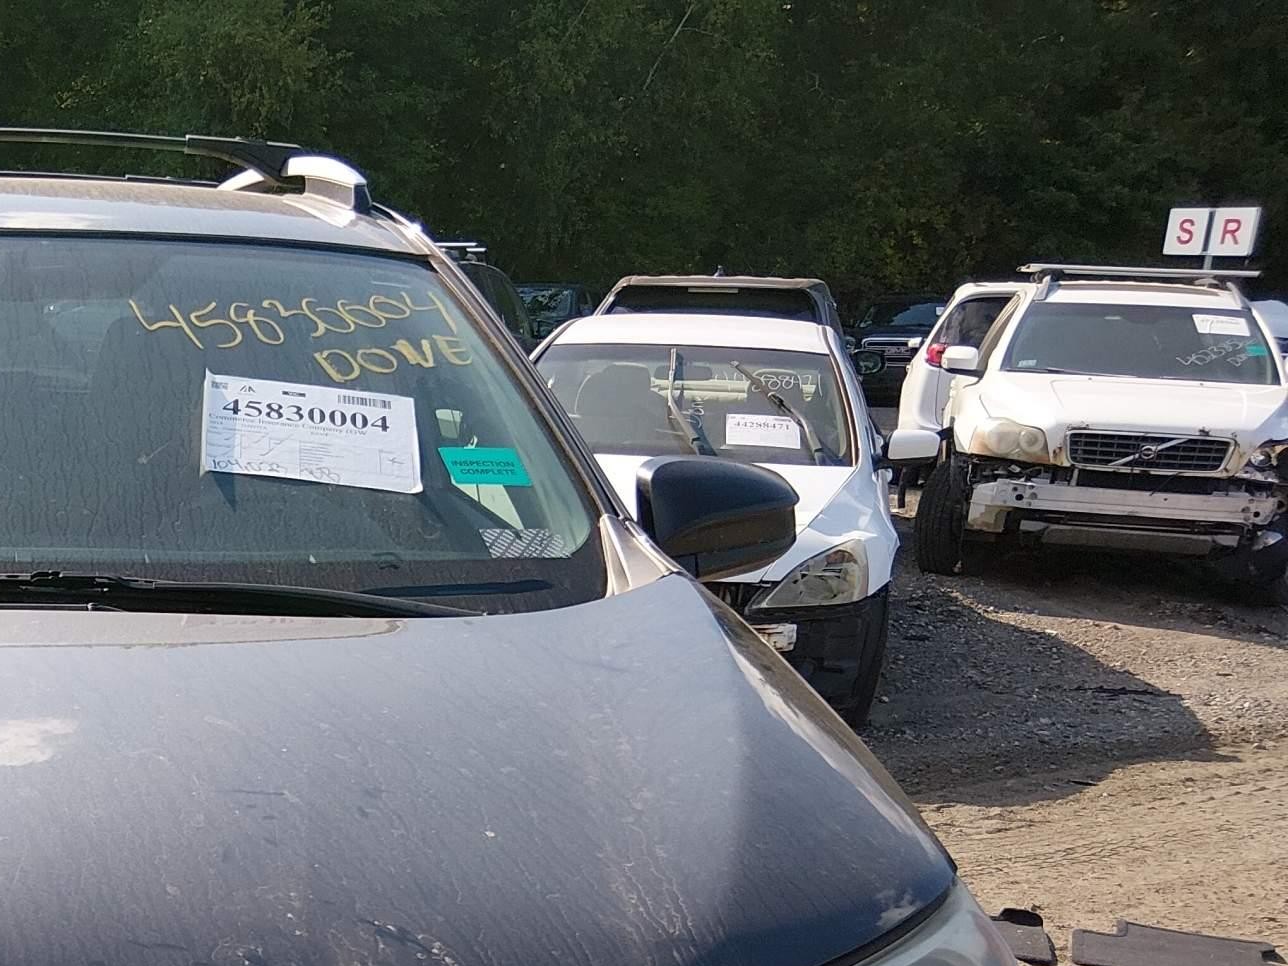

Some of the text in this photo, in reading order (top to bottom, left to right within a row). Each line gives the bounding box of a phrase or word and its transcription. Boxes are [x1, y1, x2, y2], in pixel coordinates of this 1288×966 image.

[1176, 218, 1242, 245] S R
[128, 292, 459, 349] 45830004
[314, 335, 474, 383] DONE
[222, 398, 390, 433] 45830004
[258, 418, 300, 430] Insurance
[302, 423, 344, 436] Company
[451, 460, 515, 468] INSPECTION
[460, 468, 516, 476] COMPLETE
